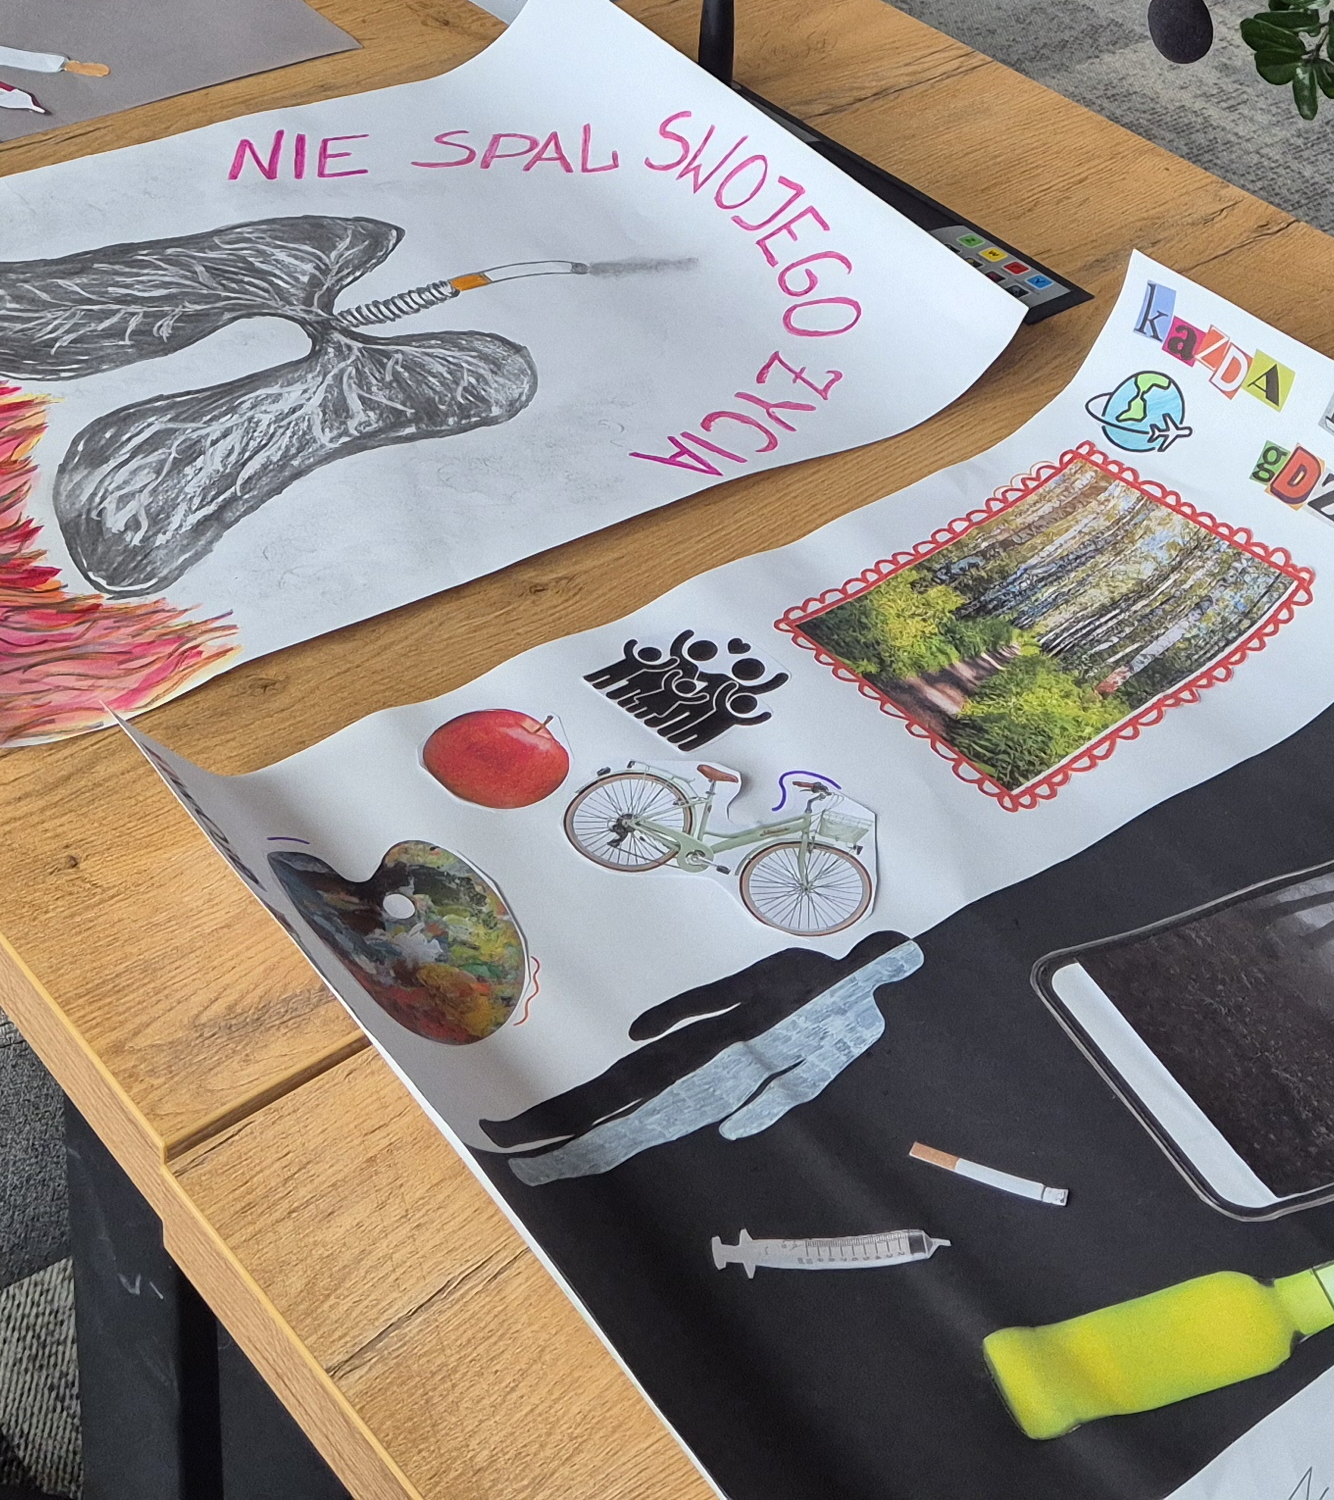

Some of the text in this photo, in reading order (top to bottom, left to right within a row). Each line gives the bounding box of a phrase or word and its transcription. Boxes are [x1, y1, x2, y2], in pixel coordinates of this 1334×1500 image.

[227, 128, 370, 181] NIE
[410, 122, 620, 174] SPAL
[643, 109, 862, 338] SWOJEGO
